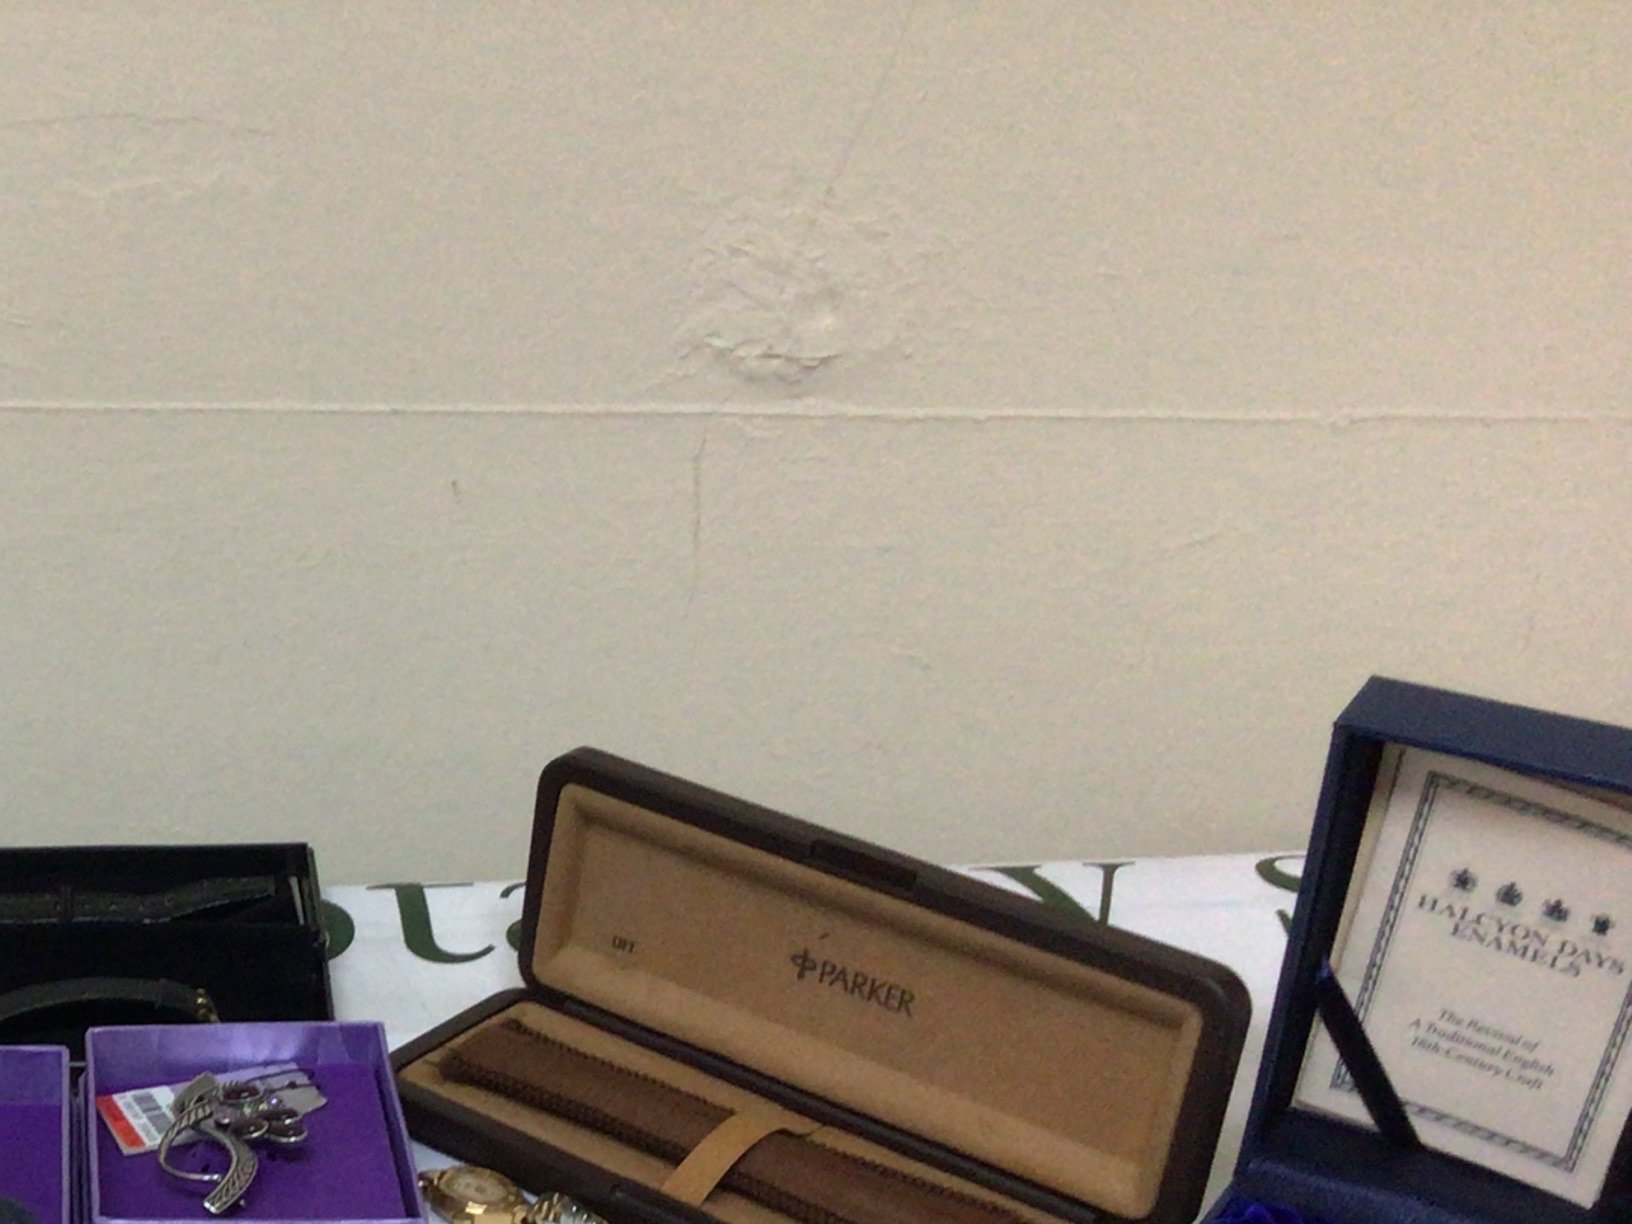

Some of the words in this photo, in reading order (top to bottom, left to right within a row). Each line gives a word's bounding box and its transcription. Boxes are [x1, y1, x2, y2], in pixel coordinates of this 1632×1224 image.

[1418, 893, 1550, 948] HALCYON
[1558, 939, 1625, 977] DAYS
[1451, 921, 1582, 979] ENAMELS
[818, 958, 916, 1018] PARKER
[1438, 1008, 1465, 1027] The
[1407, 1017, 1421, 1031] A
[1425, 1022, 1504, 1056] Traditional
[1502, 1048, 1555, 1078] English
[1505, 1067, 1544, 1091] Craft
